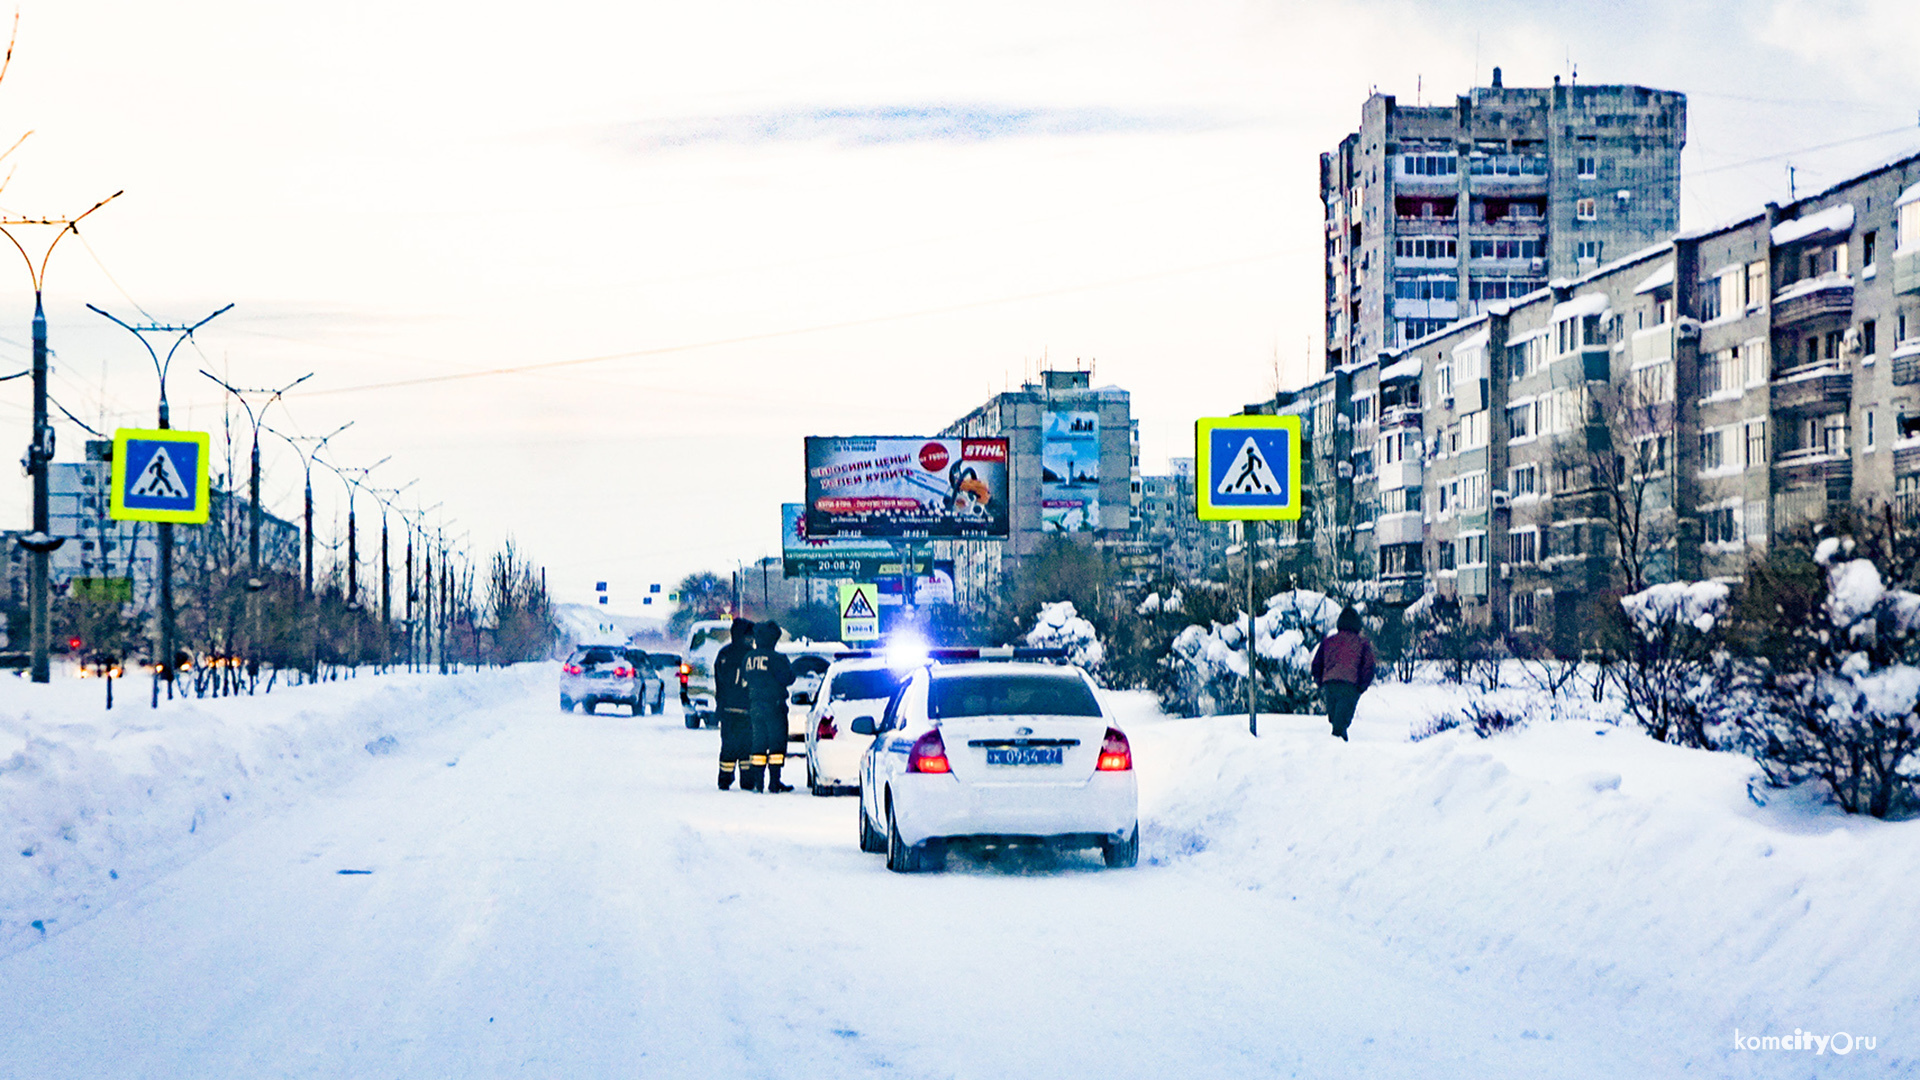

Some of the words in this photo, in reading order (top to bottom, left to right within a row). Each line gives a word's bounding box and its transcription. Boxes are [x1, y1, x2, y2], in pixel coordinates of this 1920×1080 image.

[964, 444, 1004, 458] STIHL
[865, 468, 914, 484] КУПИТЬ
[818, 560, 861, 571] 20-08-20
